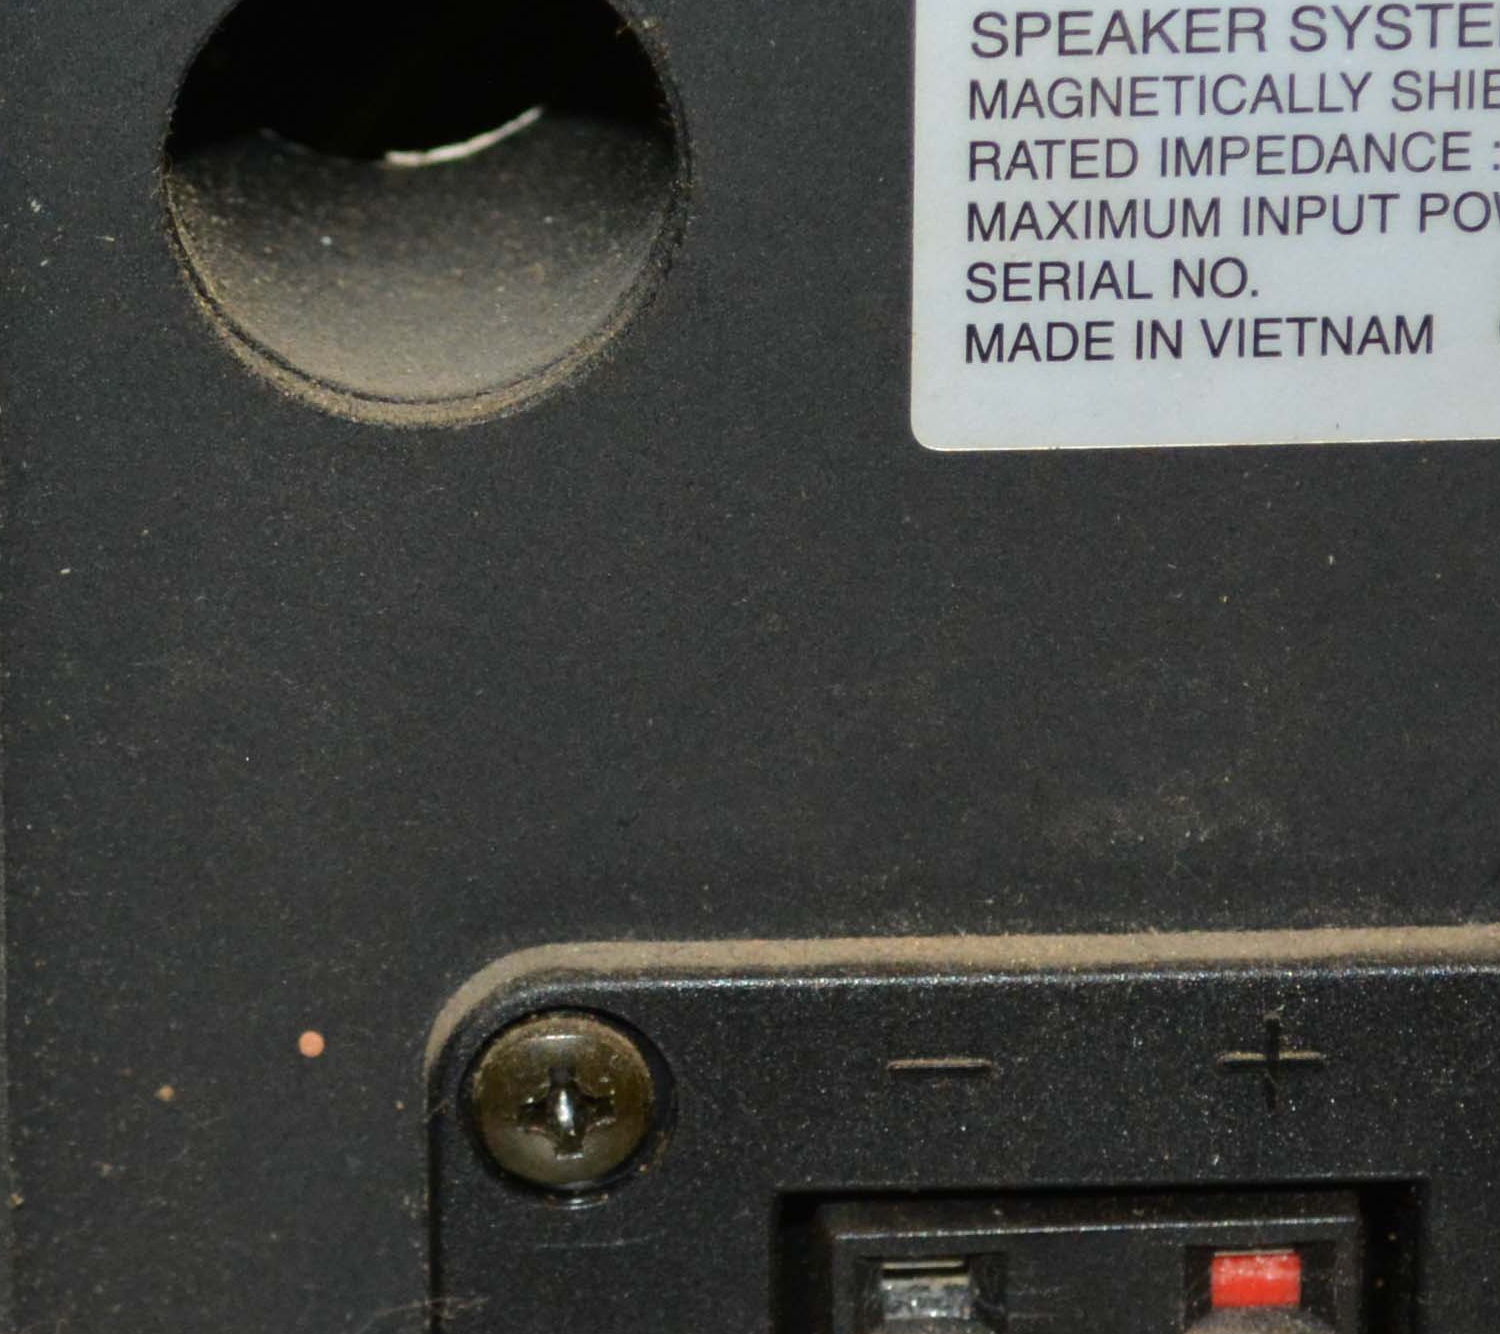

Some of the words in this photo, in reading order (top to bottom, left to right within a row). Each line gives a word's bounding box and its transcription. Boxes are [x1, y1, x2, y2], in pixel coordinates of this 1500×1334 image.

[971, 7, 1267, 59] SPEAKER
[969, 71, 1373, 121] MAGNETICALLY
[968, 138, 1139, 182] RATED
[1160, 130, 1472, 178] IMPEDANCE
[967, 197, 1221, 243] MAXIMUM
[1242, 193, 1401, 237] INPUT
[965, 259, 1154, 304] SERIAL
[1172, 256, 1259, 299] NO.
[965, 320, 1115, 364] MADE
[1135, 319, 1183, 361] IN
[1205, 314, 1434, 359] VIETNAM
